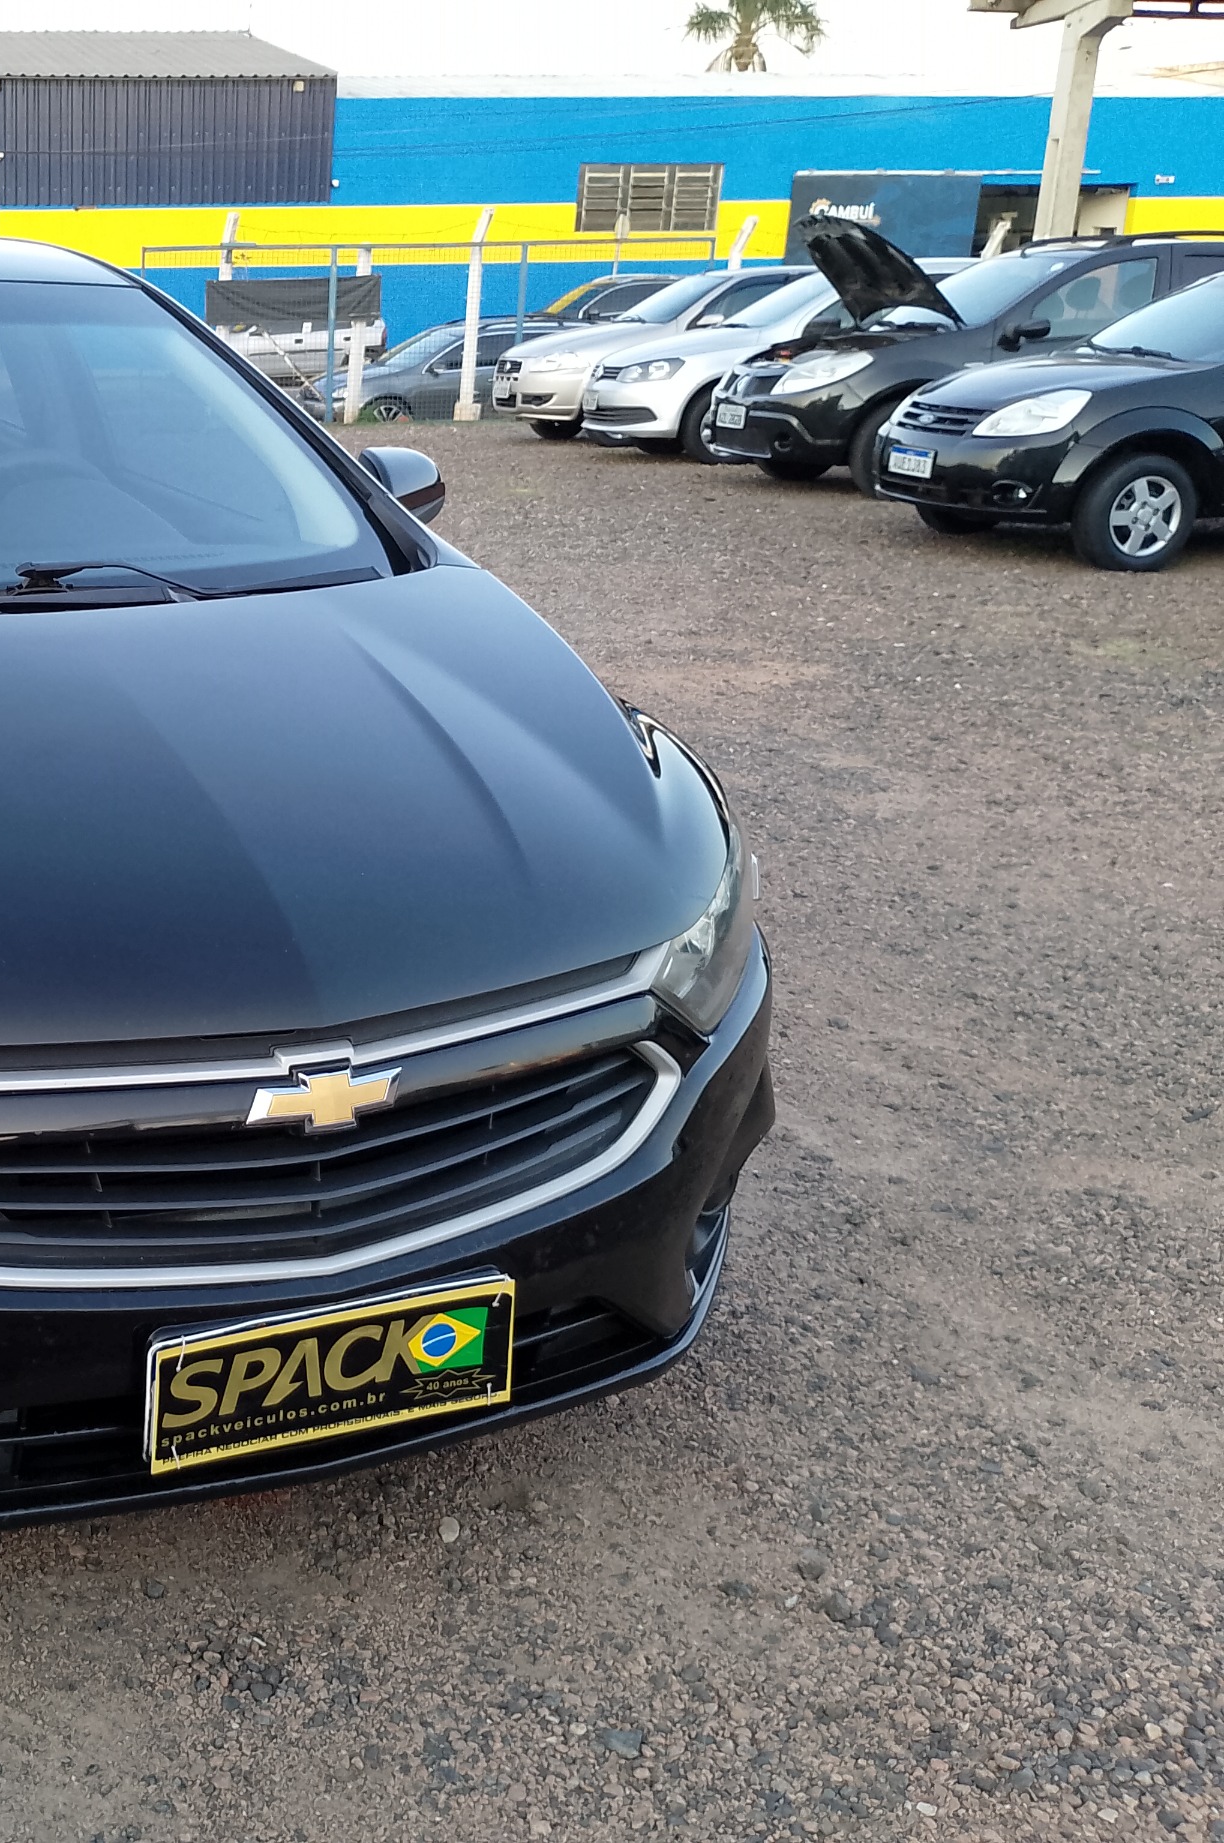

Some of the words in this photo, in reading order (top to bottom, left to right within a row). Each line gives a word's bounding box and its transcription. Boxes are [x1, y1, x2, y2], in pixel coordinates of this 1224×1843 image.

[162, 1314, 436, 1428] SPACK
[426, 1380, 440, 1391] 40
[442, 1377, 469, 1389] anos
[161, 1391, 386, 1447] spackveiculos.com.br
[216, 1433, 278, 1453] NEGOCIAR
[281, 1426, 309, 1440] COM
